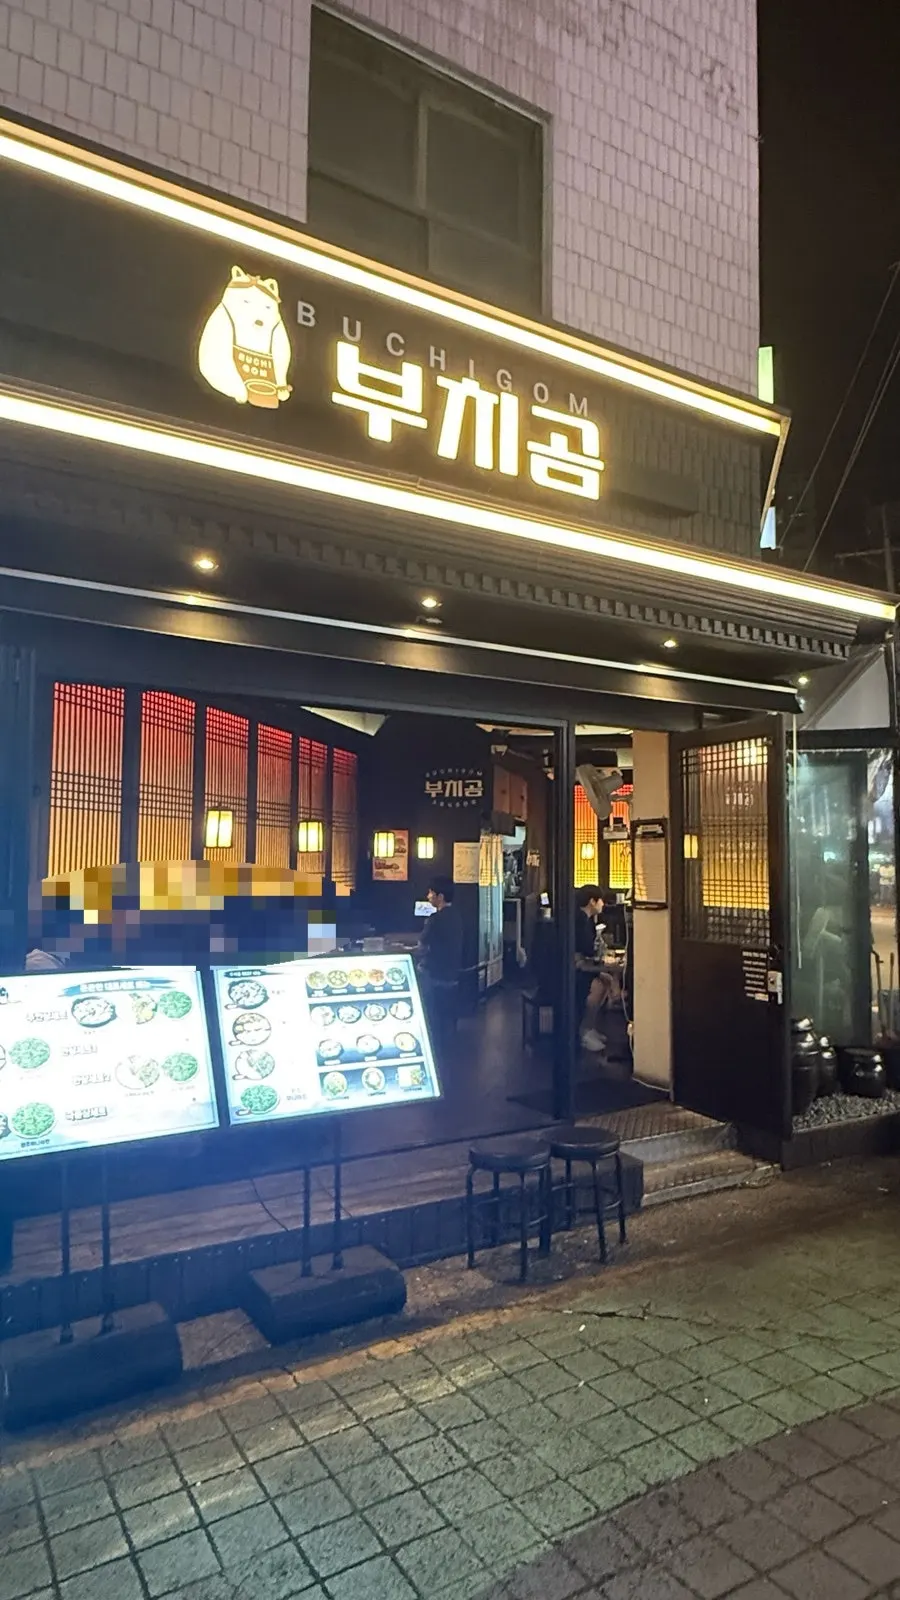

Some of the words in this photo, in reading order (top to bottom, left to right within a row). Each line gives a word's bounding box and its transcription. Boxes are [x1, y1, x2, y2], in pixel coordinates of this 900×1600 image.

[238, 352, 272, 369] BUCHI
[297, 300, 588, 417] BUCHIGOM
[331, 340, 605, 501] 부치곰
[424, 779, 484, 798] 부치곰
